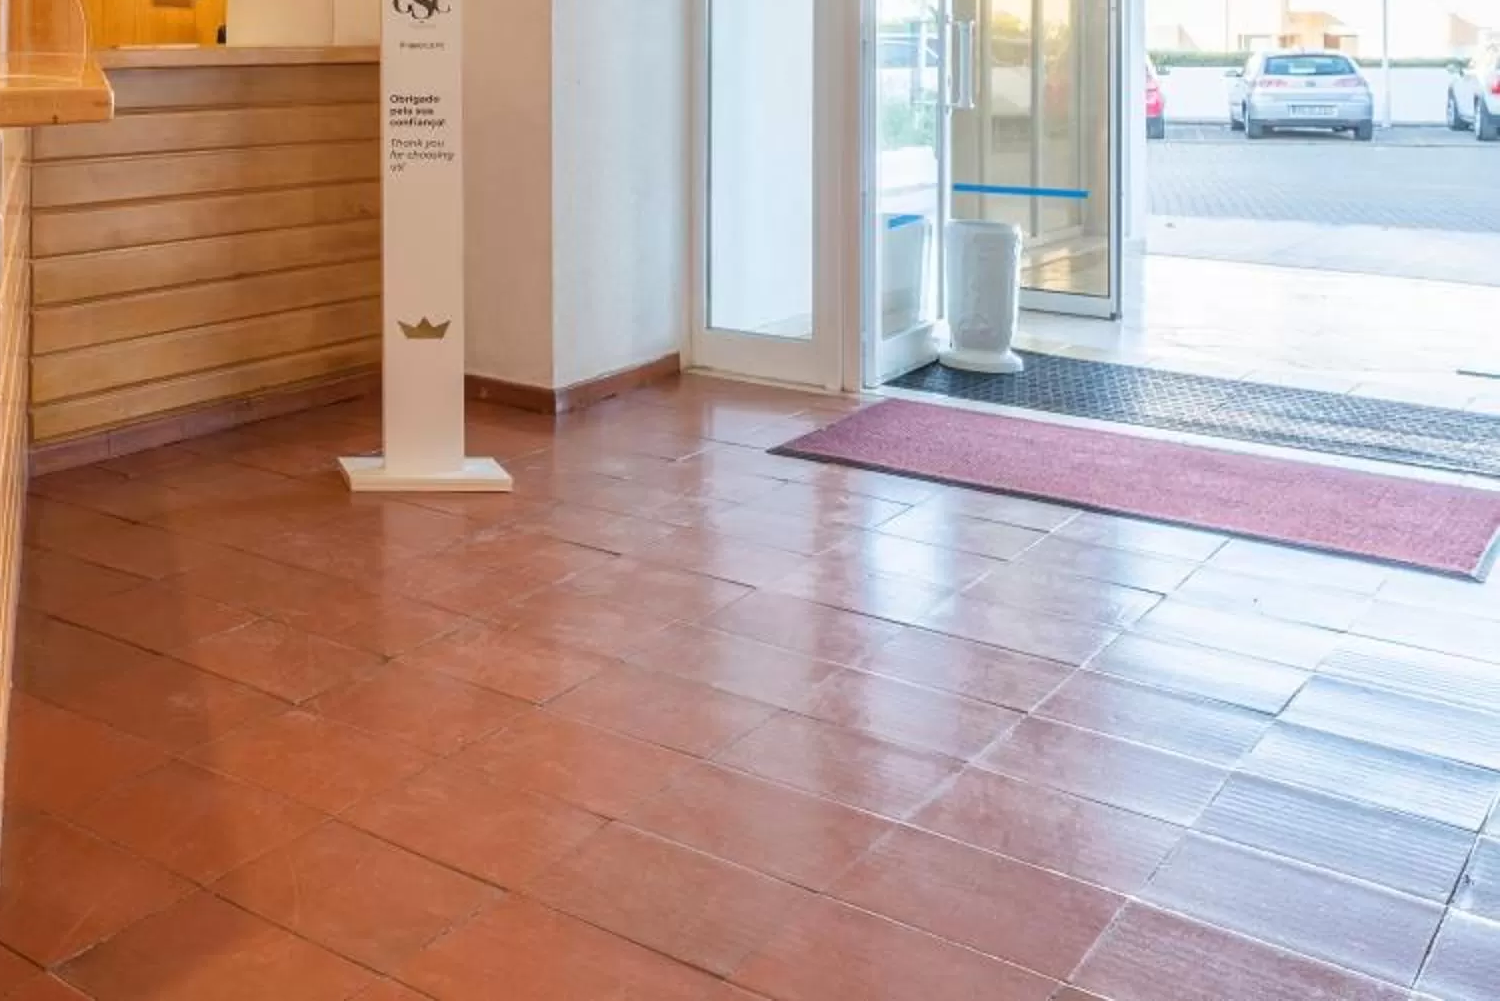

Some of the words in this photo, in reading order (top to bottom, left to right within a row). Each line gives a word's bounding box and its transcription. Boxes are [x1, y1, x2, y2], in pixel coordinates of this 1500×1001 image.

[389, 94, 441, 105] Obrigado
[389, 106, 413, 117] pela
[390, 138, 422, 148] Thank
[424, 140, 445, 150] you
[406, 150, 455, 161] choosing
